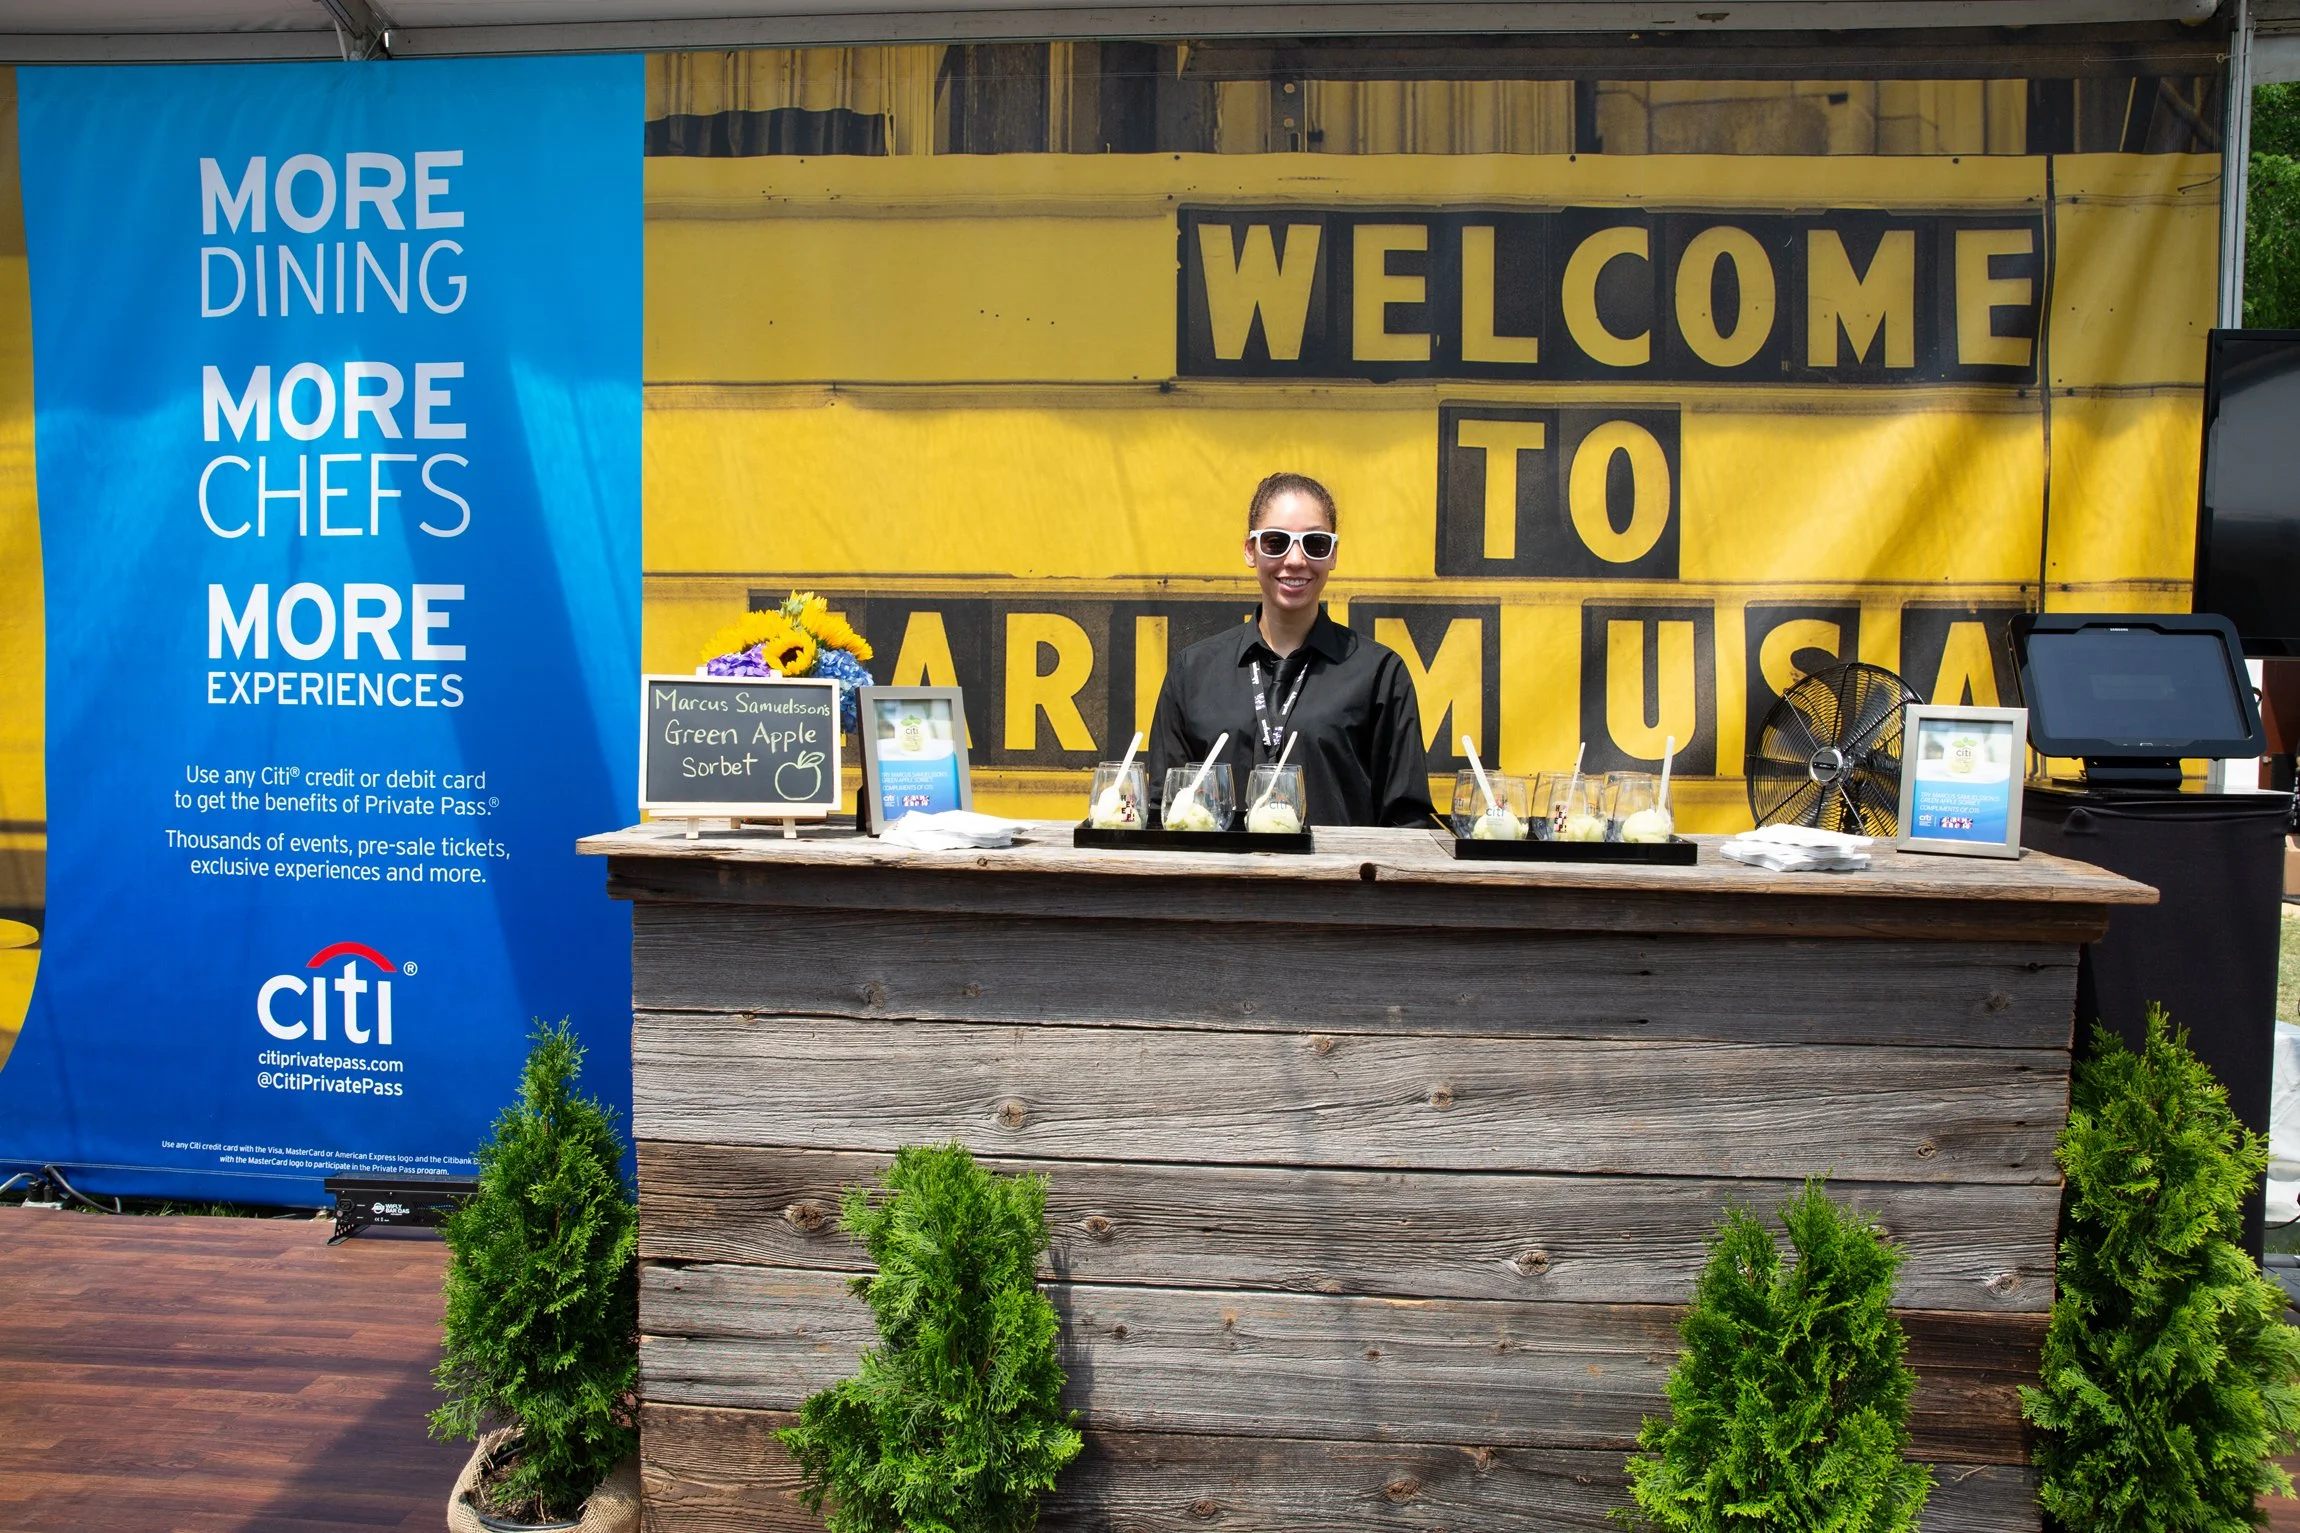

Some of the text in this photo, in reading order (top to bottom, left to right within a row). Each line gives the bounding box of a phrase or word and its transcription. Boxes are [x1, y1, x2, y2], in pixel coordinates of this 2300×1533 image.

[200, 150, 464, 234] MORE
[201, 240, 467, 317] DINING
[1198, 223, 2034, 369] WELCOME
[203, 362, 466, 442] MORE
[199, 453, 470, 538] CHEFS
[1457, 418, 1670, 564] TO
[209, 583, 465, 660] MORE
[208, 672, 463, 707] EXPERIENCES
[655, 689, 831, 717] Marcus Samuelsson's
[665, 718, 818, 753] Green Apple
[187, 765, 219, 783] Use
[225, 770, 255, 788] any
[306, 769, 354, 787] credit
[360, 773, 380, 787] or
[386, 770, 436, 788] debit
[443, 771, 485, 789] card
[682, 752, 758, 779] Sorbet
[175, 790, 191, 808] to
[198, 792, 225, 812] get
[231, 792, 259, 810] the
[266, 793, 337, 812] benefits
[343, 795, 359, 813] of
[366, 796, 434, 814] Private
[165, 830, 509, 859] Thousands of events, pre-sale tickets,
[191, 857, 486, 882] exclusive experiences and more.
[258, 1050, 403, 1073] citiprivatepass.com
[258, 1070, 403, 1096] @CitiPrivatePass
[176, 1142, 188, 1150] any
[202, 1143, 221, 1151] credit
[223, 1144, 238, 1152] card
[268, 1147, 284, 1155] Visa,
[286, 1148, 324, 1157] MasterCard
[335, 1151, 367, 1160] American
[369, 1153, 396, 1162] Express
[398, 1155, 413, 1163] logo
[443, 1157, 472, 1165] Citibank
[248, 1157, 287, 1166] MasterCard
[289, 1160, 304, 1168] logo
[314, 1161, 350, 1171] participate
